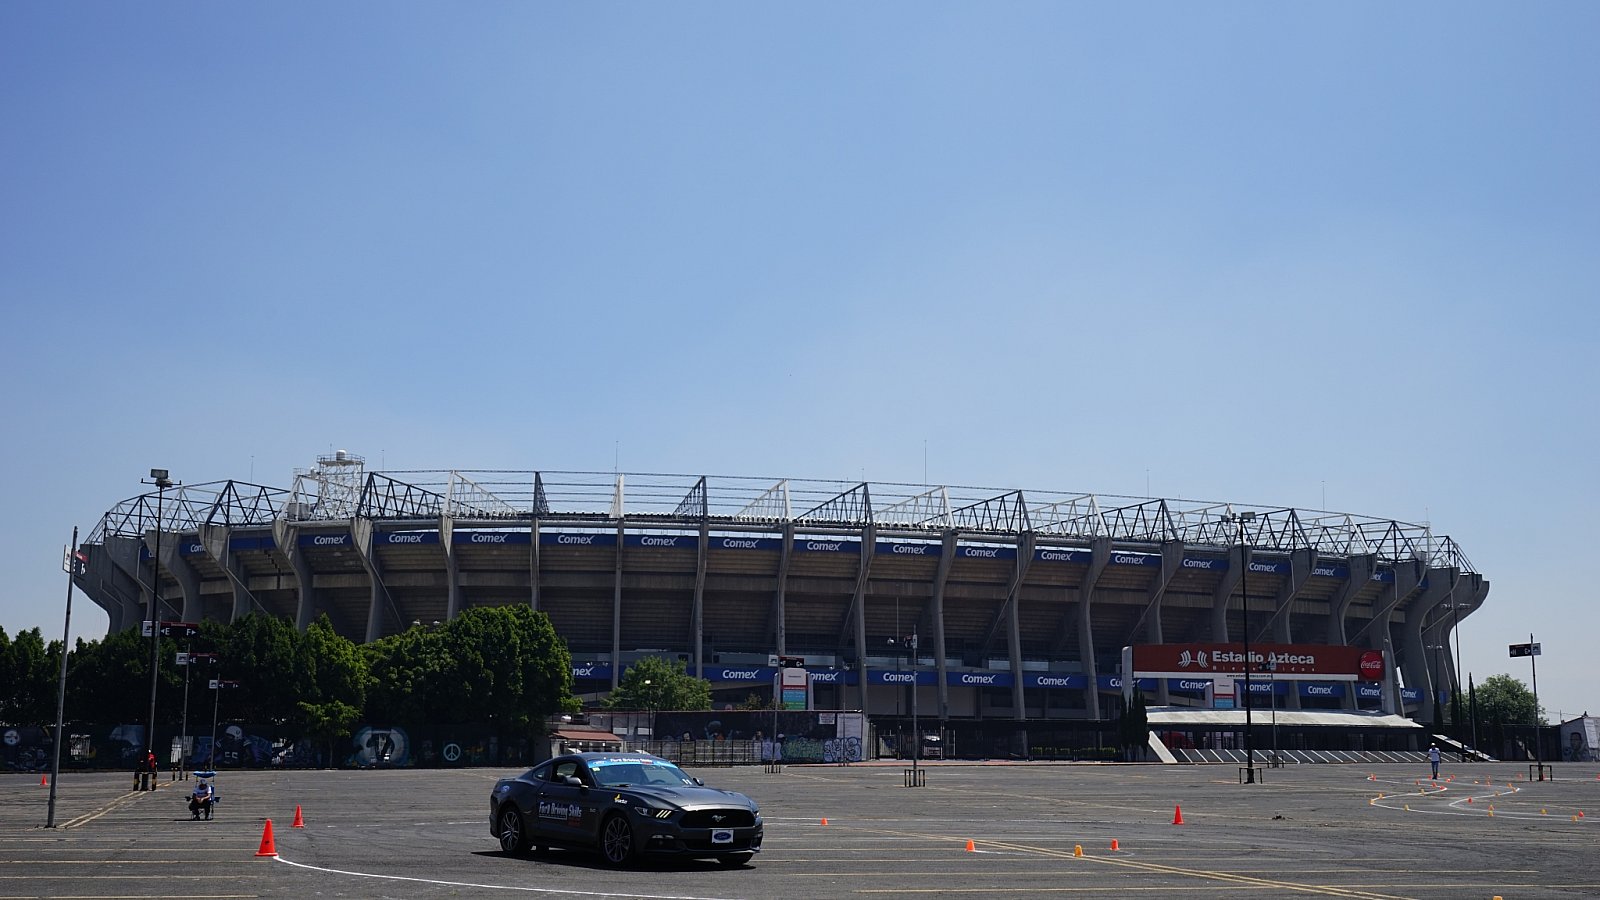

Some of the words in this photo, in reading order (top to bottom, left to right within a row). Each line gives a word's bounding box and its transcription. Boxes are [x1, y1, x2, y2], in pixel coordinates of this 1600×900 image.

[314, 534, 347, 545] Comex
[389, 533, 425, 544] Comex
[471, 533, 508, 543] Comex
[557, 534, 595, 544] Comex
[641, 536, 678, 546] Comex
[723, 538, 760, 549] Comex
[807, 541, 842, 551] Comex
[893, 544, 927, 555] Comex
[965, 548, 999, 558] Comex
[1041, 552, 1073, 561] Comex
[1115, 555, 1146, 565] Comex
[1183, 559, 1213, 569] Comex
[1249, 563, 1278, 573] Comex
[186, 628, 191, 636] F
[1212, 650, 1264, 663] Estadio
[1267, 651, 1315, 665] Azteca
[723, 669, 760, 679] Comex
[810, 671, 840, 681] omex
[883, 672, 918, 682] Comex
[962, 674, 996, 684] Comex
[1037, 676, 1070, 686] Comex
[1307, 685, 1333, 695] Comex
[1360, 687, 1382, 697] Comex
[1402, 690, 1417, 699] Comex
[551, 802, 568, 818] Driving
[568, 804, 582, 818] Skills
